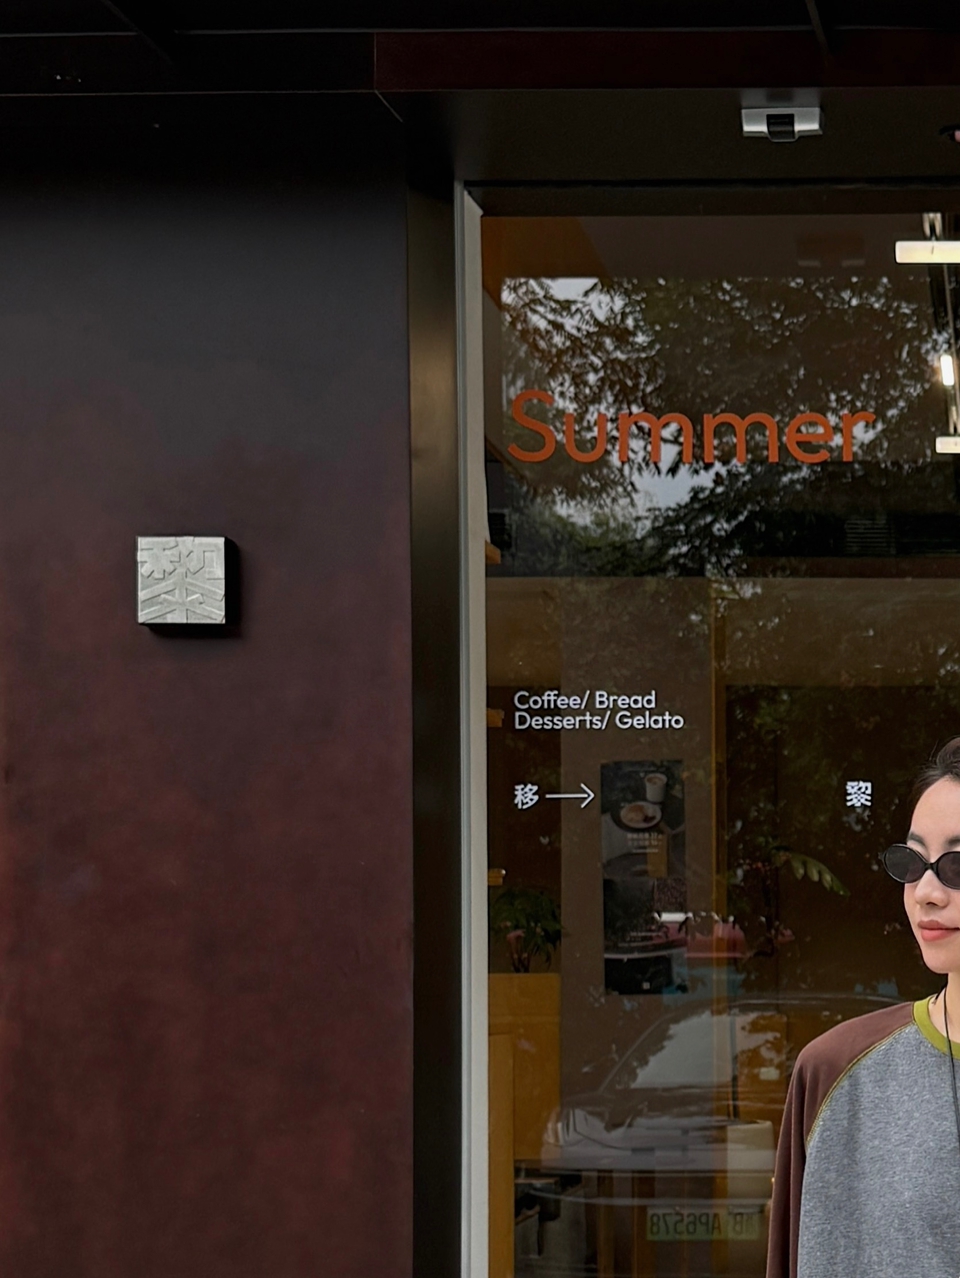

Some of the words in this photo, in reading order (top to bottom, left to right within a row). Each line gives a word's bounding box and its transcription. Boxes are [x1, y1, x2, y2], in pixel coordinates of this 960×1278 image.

[508, 389, 876, 463] Summer
[514, 690, 590, 709] Coffee/
[595, 690, 656, 709] Bread
[514, 711, 611, 730] Desserts/
[615, 711, 684, 729] Gelato
[514, 783, 539, 809] 移
